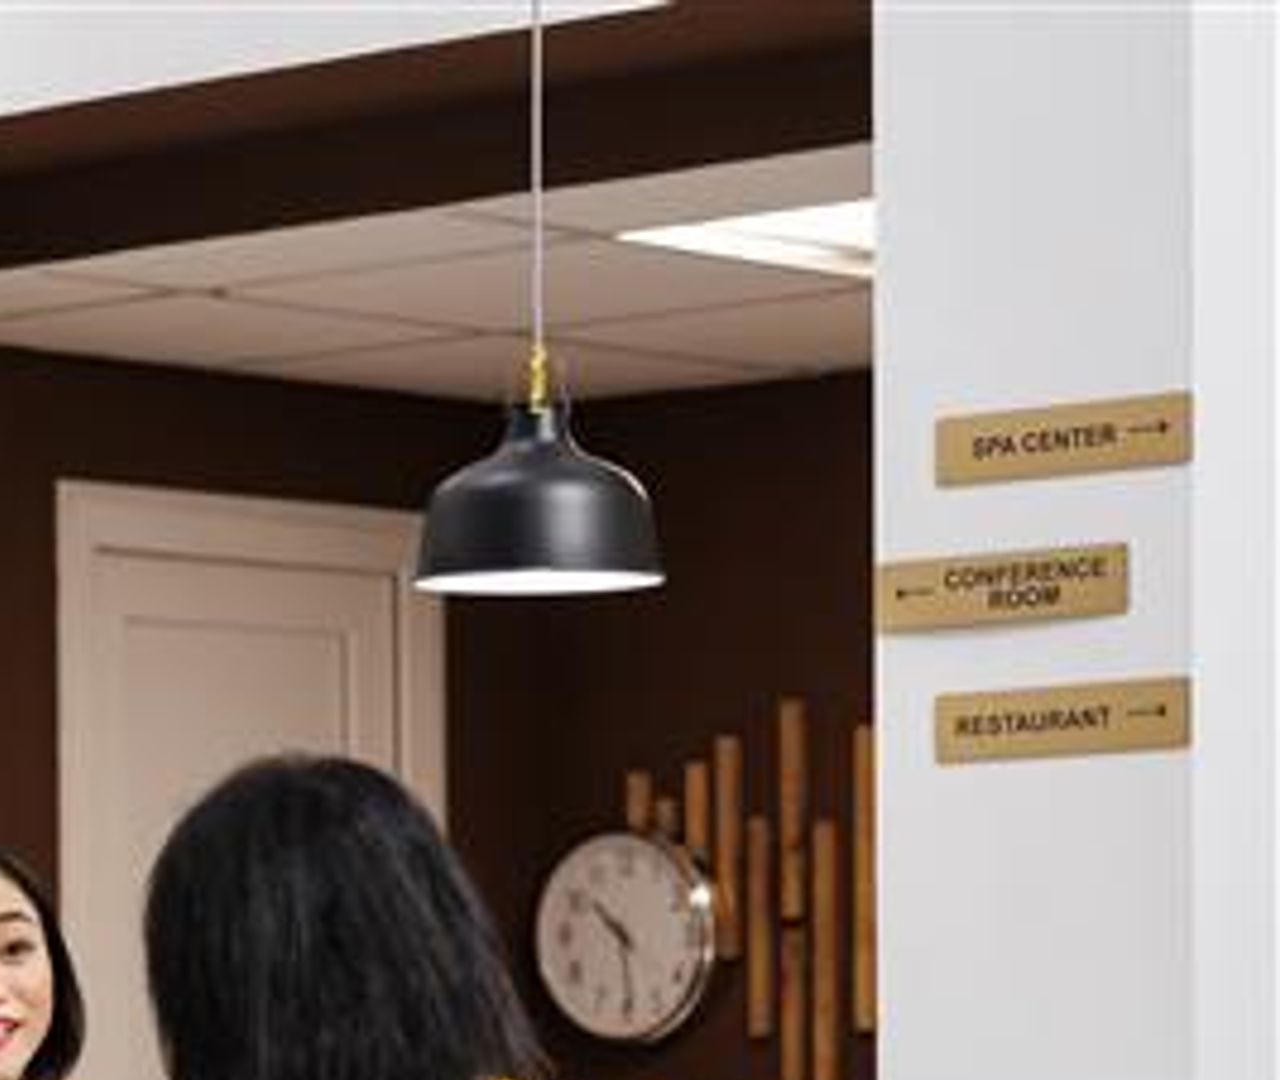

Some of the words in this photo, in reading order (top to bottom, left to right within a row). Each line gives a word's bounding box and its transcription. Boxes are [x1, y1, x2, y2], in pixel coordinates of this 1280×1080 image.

[972, 433, 1018, 460] SPA
[1021, 423, 1118, 453] CENTER
[944, 555, 1108, 592] CONFERENCE
[987, 584, 1061, 610] ROOM
[954, 704, 1111, 737] RESTAURANT
